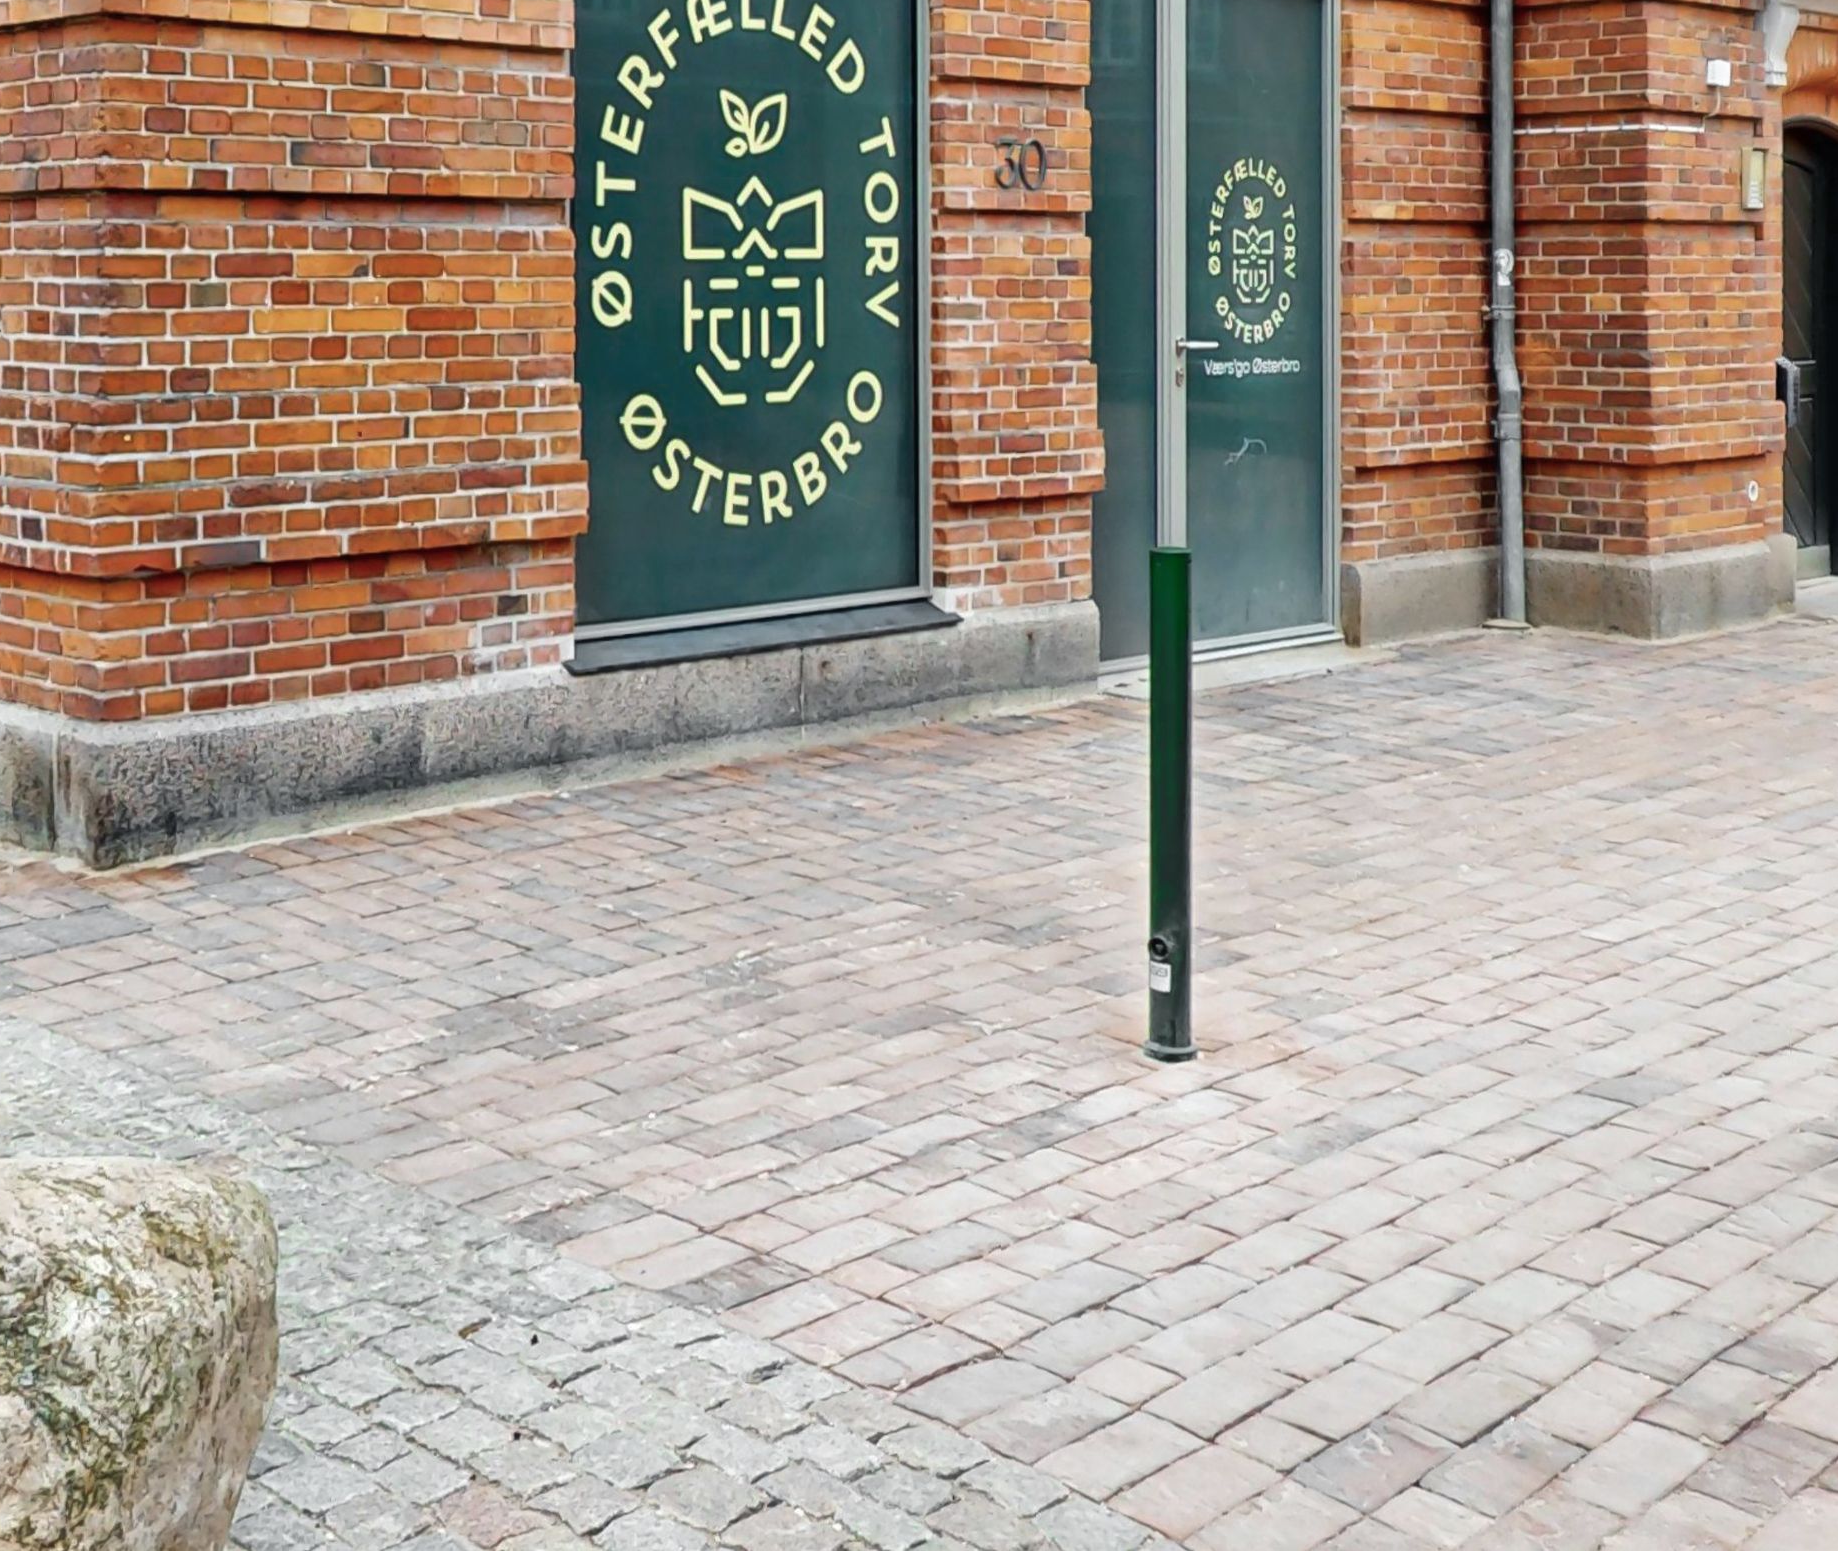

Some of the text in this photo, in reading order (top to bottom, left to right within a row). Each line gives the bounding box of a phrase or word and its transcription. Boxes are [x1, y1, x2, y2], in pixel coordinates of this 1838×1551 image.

[995, 134, 1047, 192] 30
[859, 116, 900, 328] TORV
[1207, 157, 1297, 279] ØSTERFÆLLED TORV
[1215, 291, 1291, 344] ØSTERBRO
[1252, 355, 1301, 375] Østerbro
[619, 370, 883, 526] ØSTERBRO
